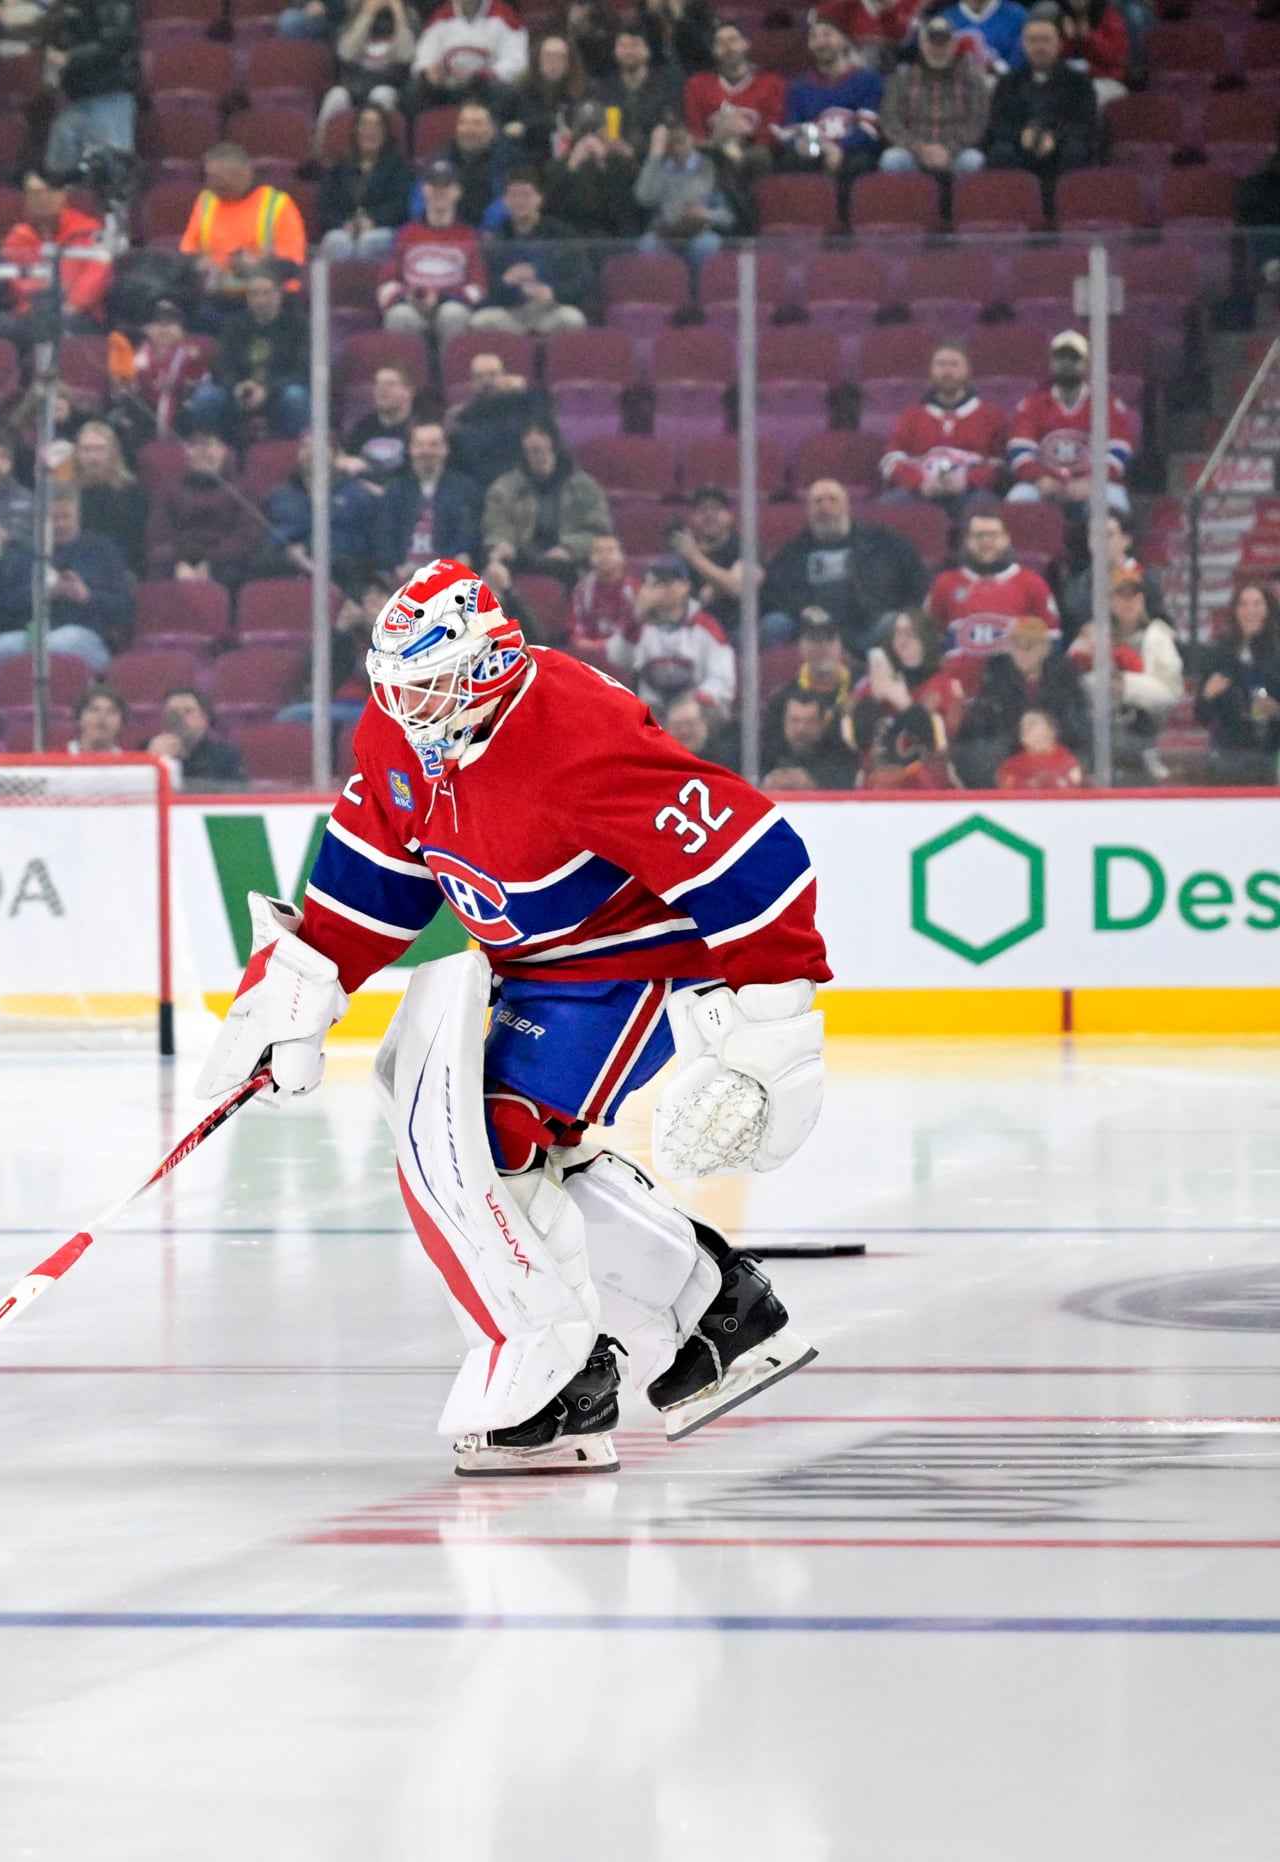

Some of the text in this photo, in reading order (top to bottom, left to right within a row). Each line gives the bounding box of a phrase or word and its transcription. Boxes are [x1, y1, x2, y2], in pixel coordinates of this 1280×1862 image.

[393, 796, 413, 809] RBC
[654, 778, 735, 854] 32
[485, 1183, 533, 1278] VAPOR
